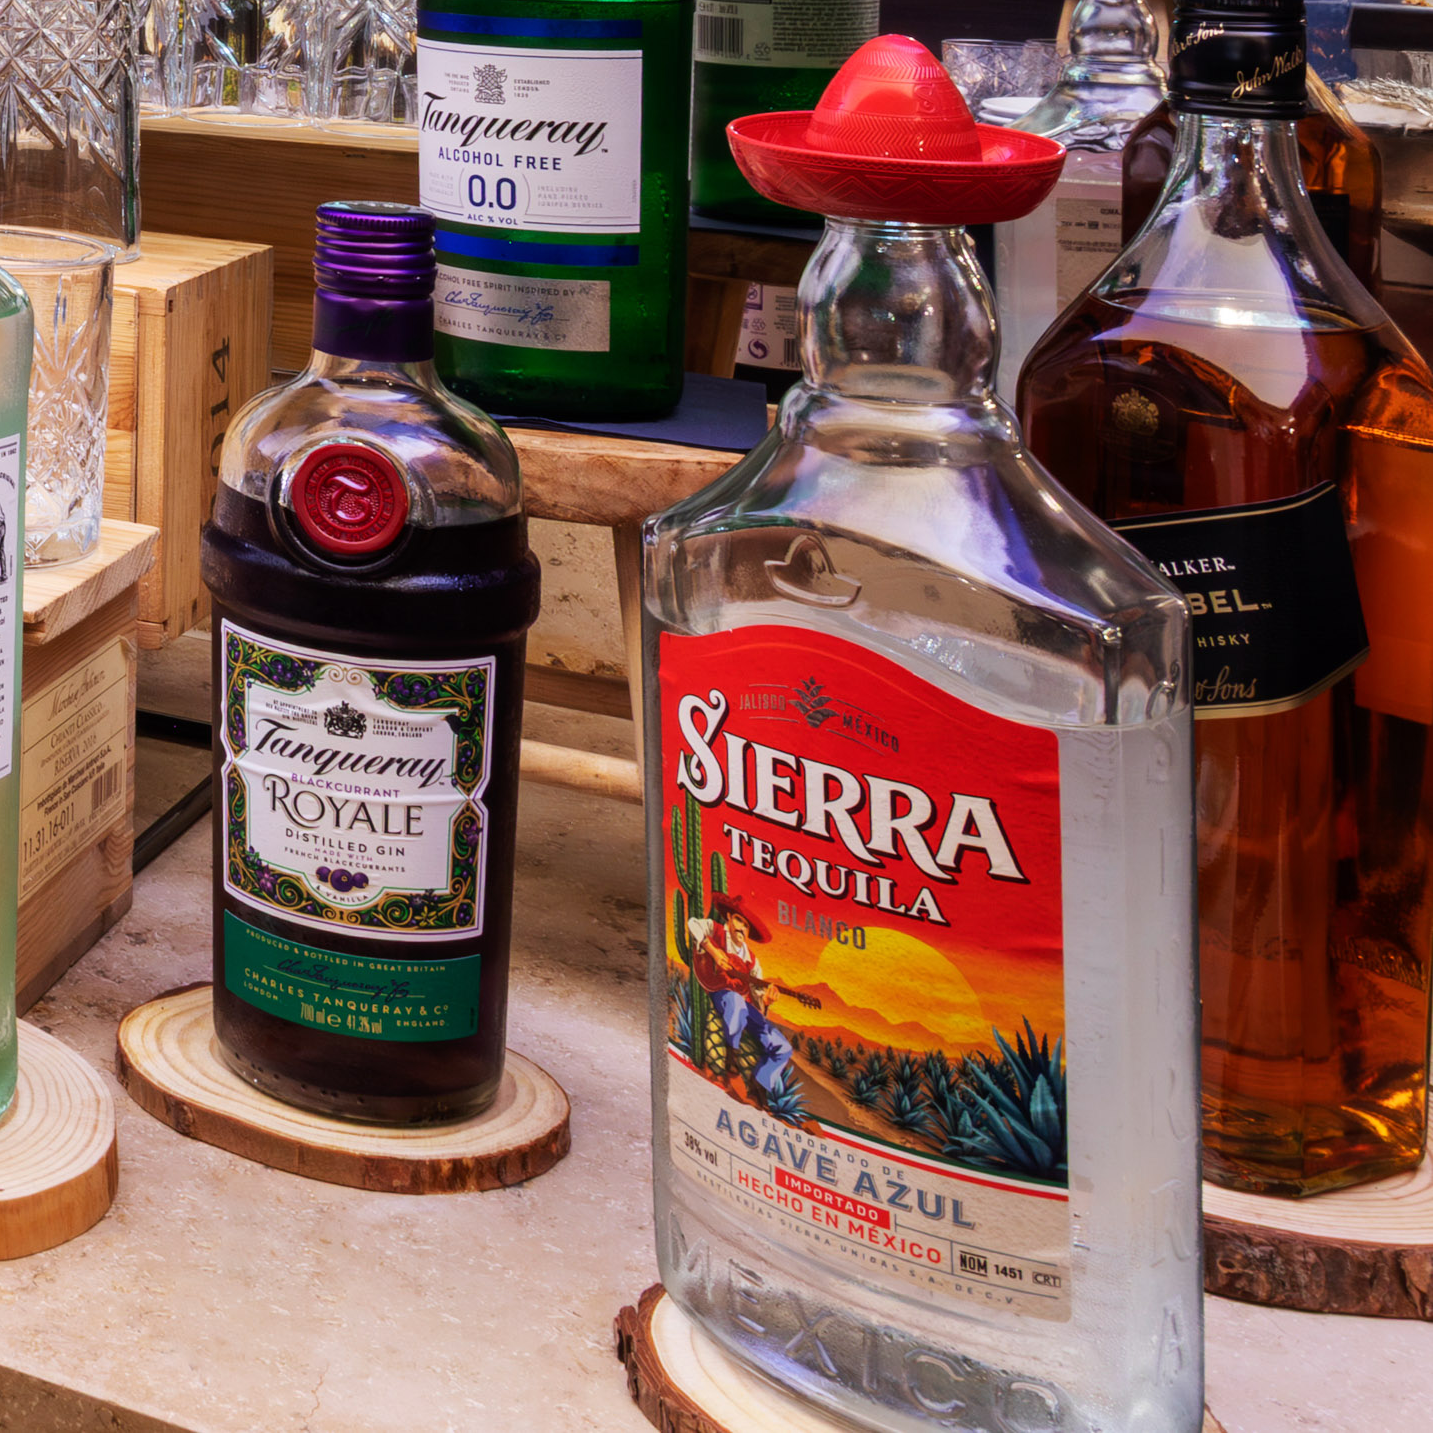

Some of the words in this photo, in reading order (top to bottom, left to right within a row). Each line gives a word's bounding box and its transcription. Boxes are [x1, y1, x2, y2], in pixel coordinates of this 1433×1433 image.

[1232, 66, 1272, 99] John
[421, 91, 608, 157] Tanqueray
[438, 146, 504, 167] ALCOHOL
[514, 155, 562, 171] FREE
[468, 174, 516, 210] 0.0
[467, 213, 483, 222] ALC
[498, 217, 519, 225] VOL
[462, 278, 481, 288] FREE
[483, 281, 511, 293] SPIRIT
[514, 285, 559, 296] INSPIRED
[438, 316, 472, 330] CHARLES
[476, 325, 540, 340] TANQUERAY
[1151, 556, 1226, 577] ALKER
[1184, 589, 1260, 616] BEL
[1196, 632, 1251, 648] HISKY
[739, 693, 787, 712] JALISCO
[841, 710, 901, 754] MÉXICO
[254, 718, 446, 790] Tanqueray
[291, 772, 401, 799] BLACKCURRANT
[676, 688, 1031, 885] SIERRA
[262, 773, 424, 837] ROYALE
[284, 846, 320, 861] FRENCH
[323, 856, 407, 873] BLACKCURRANTS
[285, 828, 367, 854] DISTILLED
[376, 845, 406, 857] GIN
[314, 846, 341, 858] MADE
[347, 852, 373, 862] WITH
[722, 822, 952, 927] TEQUILA
[326, 892, 369, 904] VANILLA
[777, 899, 868, 951] BLANCO
[245, 927, 290, 952] PRODUCED
[303, 950, 349, 966] BOTTLED
[353, 960, 364, 968] IN
[369, 962, 402, 972] GREAT
[406, 965, 447, 973] BRITAIN
[244, 967, 305, 998] CHARLES
[313, 992, 415, 1016] TANQUERAY
[419, 1006, 429, 1016] &
[300, 1002, 315, 1020] 700
[346, 1013, 370, 1033] 41.3%
[684, 1129, 703, 1156] 38%
[704, 1144, 719, 1168] vol
[760, 1116, 869, 1170] ELABORADO
[882, 1165, 906, 1180] DE
[715, 1107, 839, 1185] AGAVE
[852, 1170, 977, 1231] AZUL
[784, 1173, 880, 1222] IMPORTADO
[737, 1168, 804, 1216] HECHO
[811, 1205, 840, 1230] EN
[847, 1215, 943, 1265] MÉXICO
[779, 1217, 832, 1248] SIERRA
[839, 1243, 901, 1274] UNIDAS
[959, 1251, 989, 1275] NOM
[994, 1263, 1024, 1282] 1451
[1033, 1270, 1062, 1290] CRT
